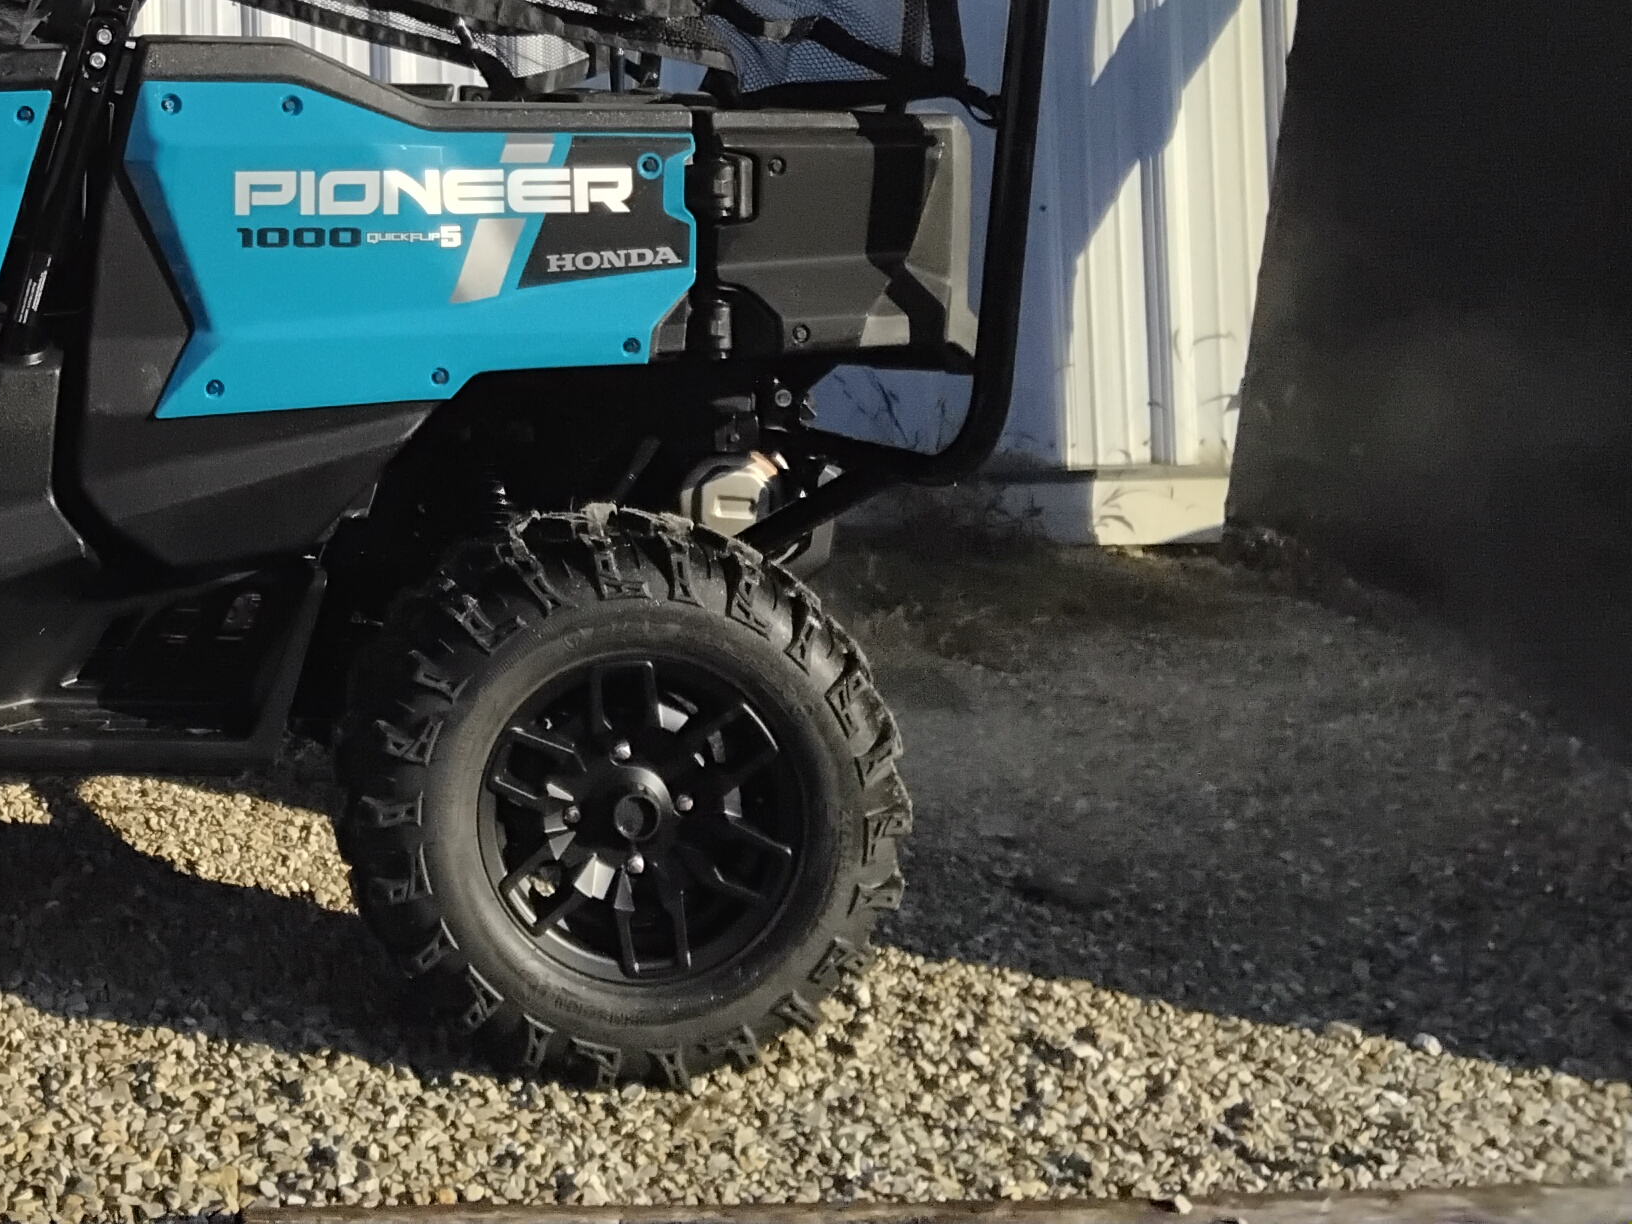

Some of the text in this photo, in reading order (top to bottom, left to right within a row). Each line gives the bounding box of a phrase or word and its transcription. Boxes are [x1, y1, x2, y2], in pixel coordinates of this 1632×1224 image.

[234, 168, 633, 216] PIONEER
[236, 226, 362, 249] 1000
[546, 246, 682, 274] HONDA
